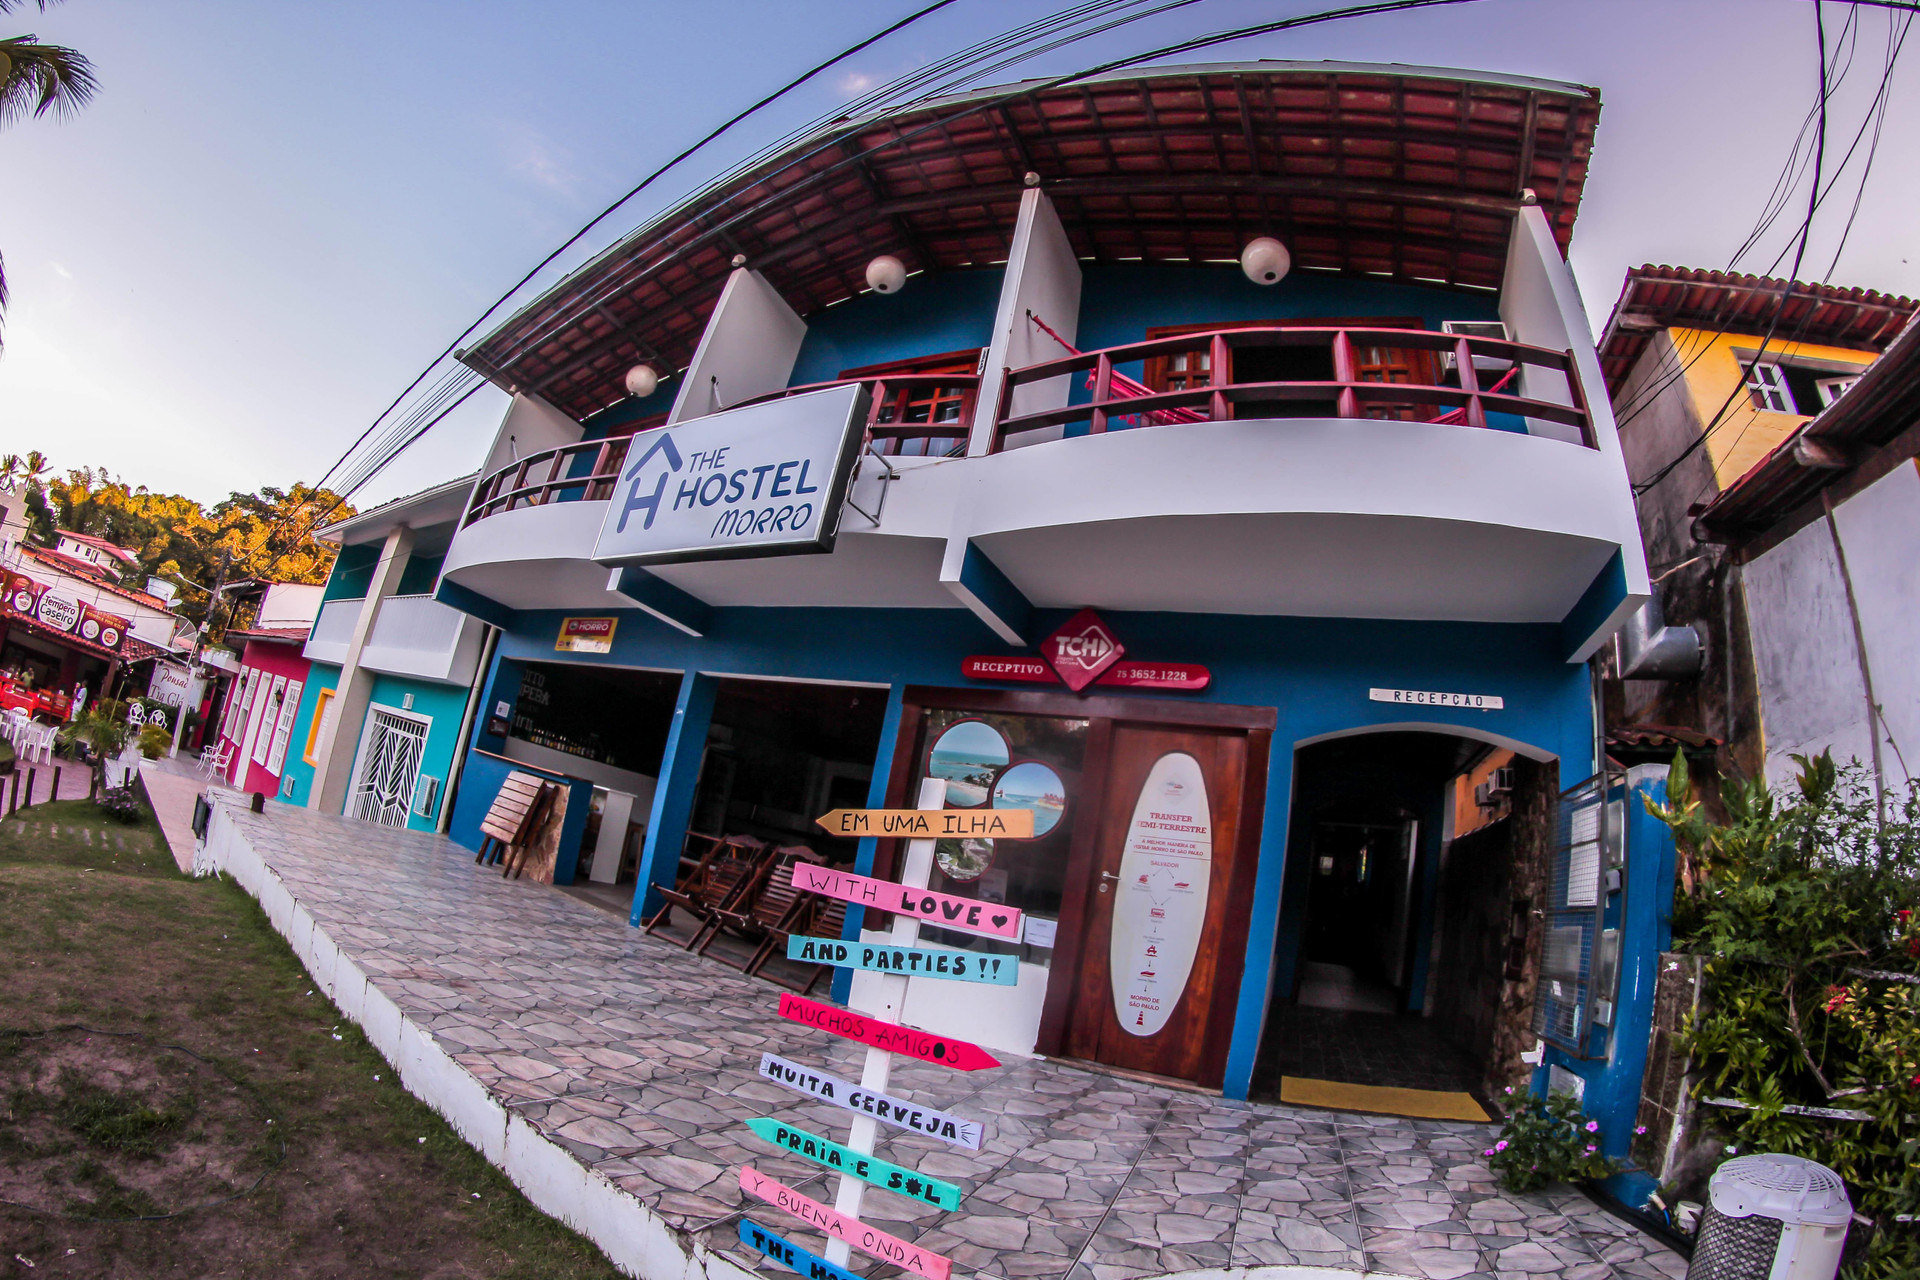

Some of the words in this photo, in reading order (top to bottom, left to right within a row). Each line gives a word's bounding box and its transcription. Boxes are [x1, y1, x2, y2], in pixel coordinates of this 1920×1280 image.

[689, 446, 731, 473] THE
[673, 459, 818, 511] HOSTEL
[710, 502, 813, 539] MORRO
[40, 603, 74, 625] Caseiro
[45, 595, 76, 615] Tempero
[578, 623, 609, 631] MORRO
[973, 661, 1044, 675] RECEPTIVO
[1117, 669, 1127, 678] 75
[1130, 669, 1188, 681] 3652.1228
[841, 813, 869, 832] EM
[883, 815, 929, 833] UMA
[942, 814, 1006, 833] ILHA
[1150, 812, 1193, 823] TRANSFER
[1150, 860, 1179, 868] SALVADOR
[809, 872, 877, 902] WITH
[900, 891, 982, 926] LOVE
[801, 941, 848, 961] AND
[863, 948, 966, 976] PARTIES
[1130, 994, 1152, 1003] MORRO
[1141, 1003, 1160, 1011] PAULO
[786, 1001, 865, 1038] MUCHOS
[875, 1028, 960, 1064] AMIGOS
[767, 1060, 835, 1098] MUITA
[849, 1092, 957, 1140] CERVEJA
[856, 1160, 869, 1178] E
[753, 1176, 765, 1192] Y
[777, 1190, 843, 1235] BUENA
[862, 1231, 923, 1271] ONDA
[752, 1230, 794, 1266] THE
